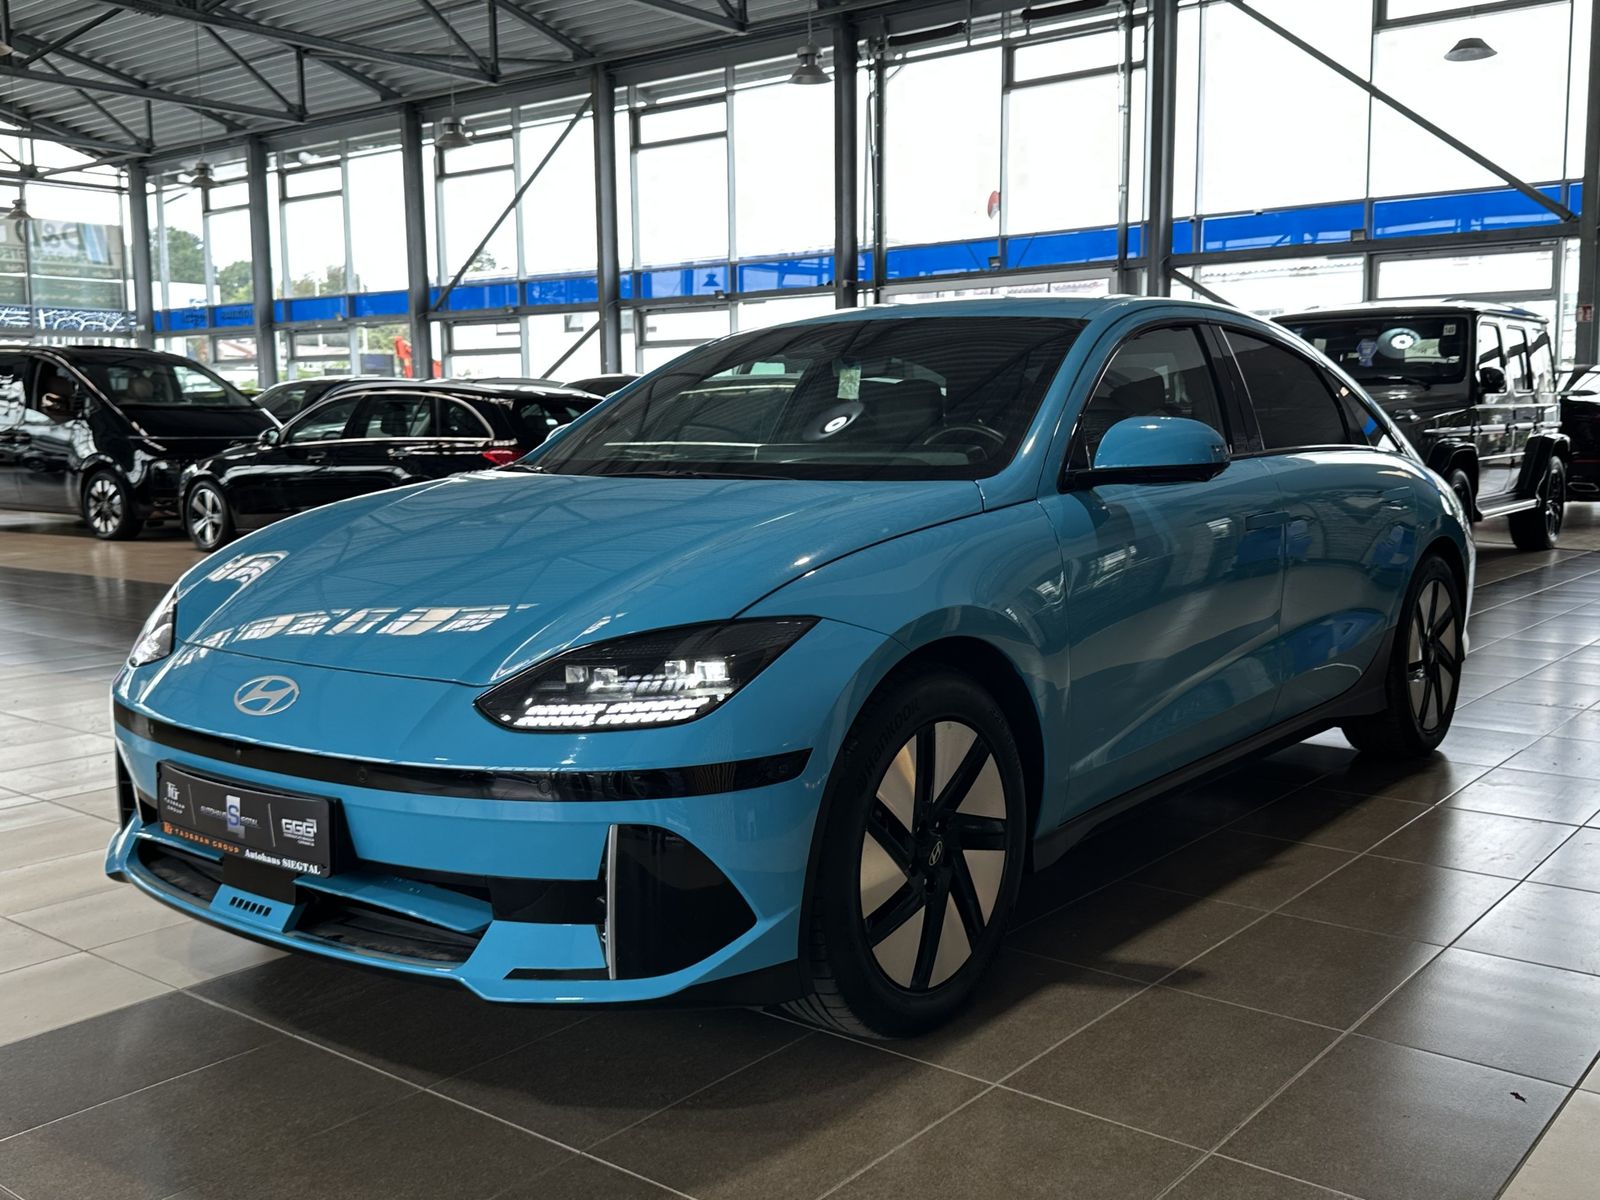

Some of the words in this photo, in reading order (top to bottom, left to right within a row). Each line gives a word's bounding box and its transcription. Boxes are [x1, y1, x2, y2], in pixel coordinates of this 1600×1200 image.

[281, 818, 315, 838] GGG
[212, 839, 239, 853] GROUP
[244, 848, 281, 866] Autohaus
[282, 857, 321, 875] SIEGTAL
